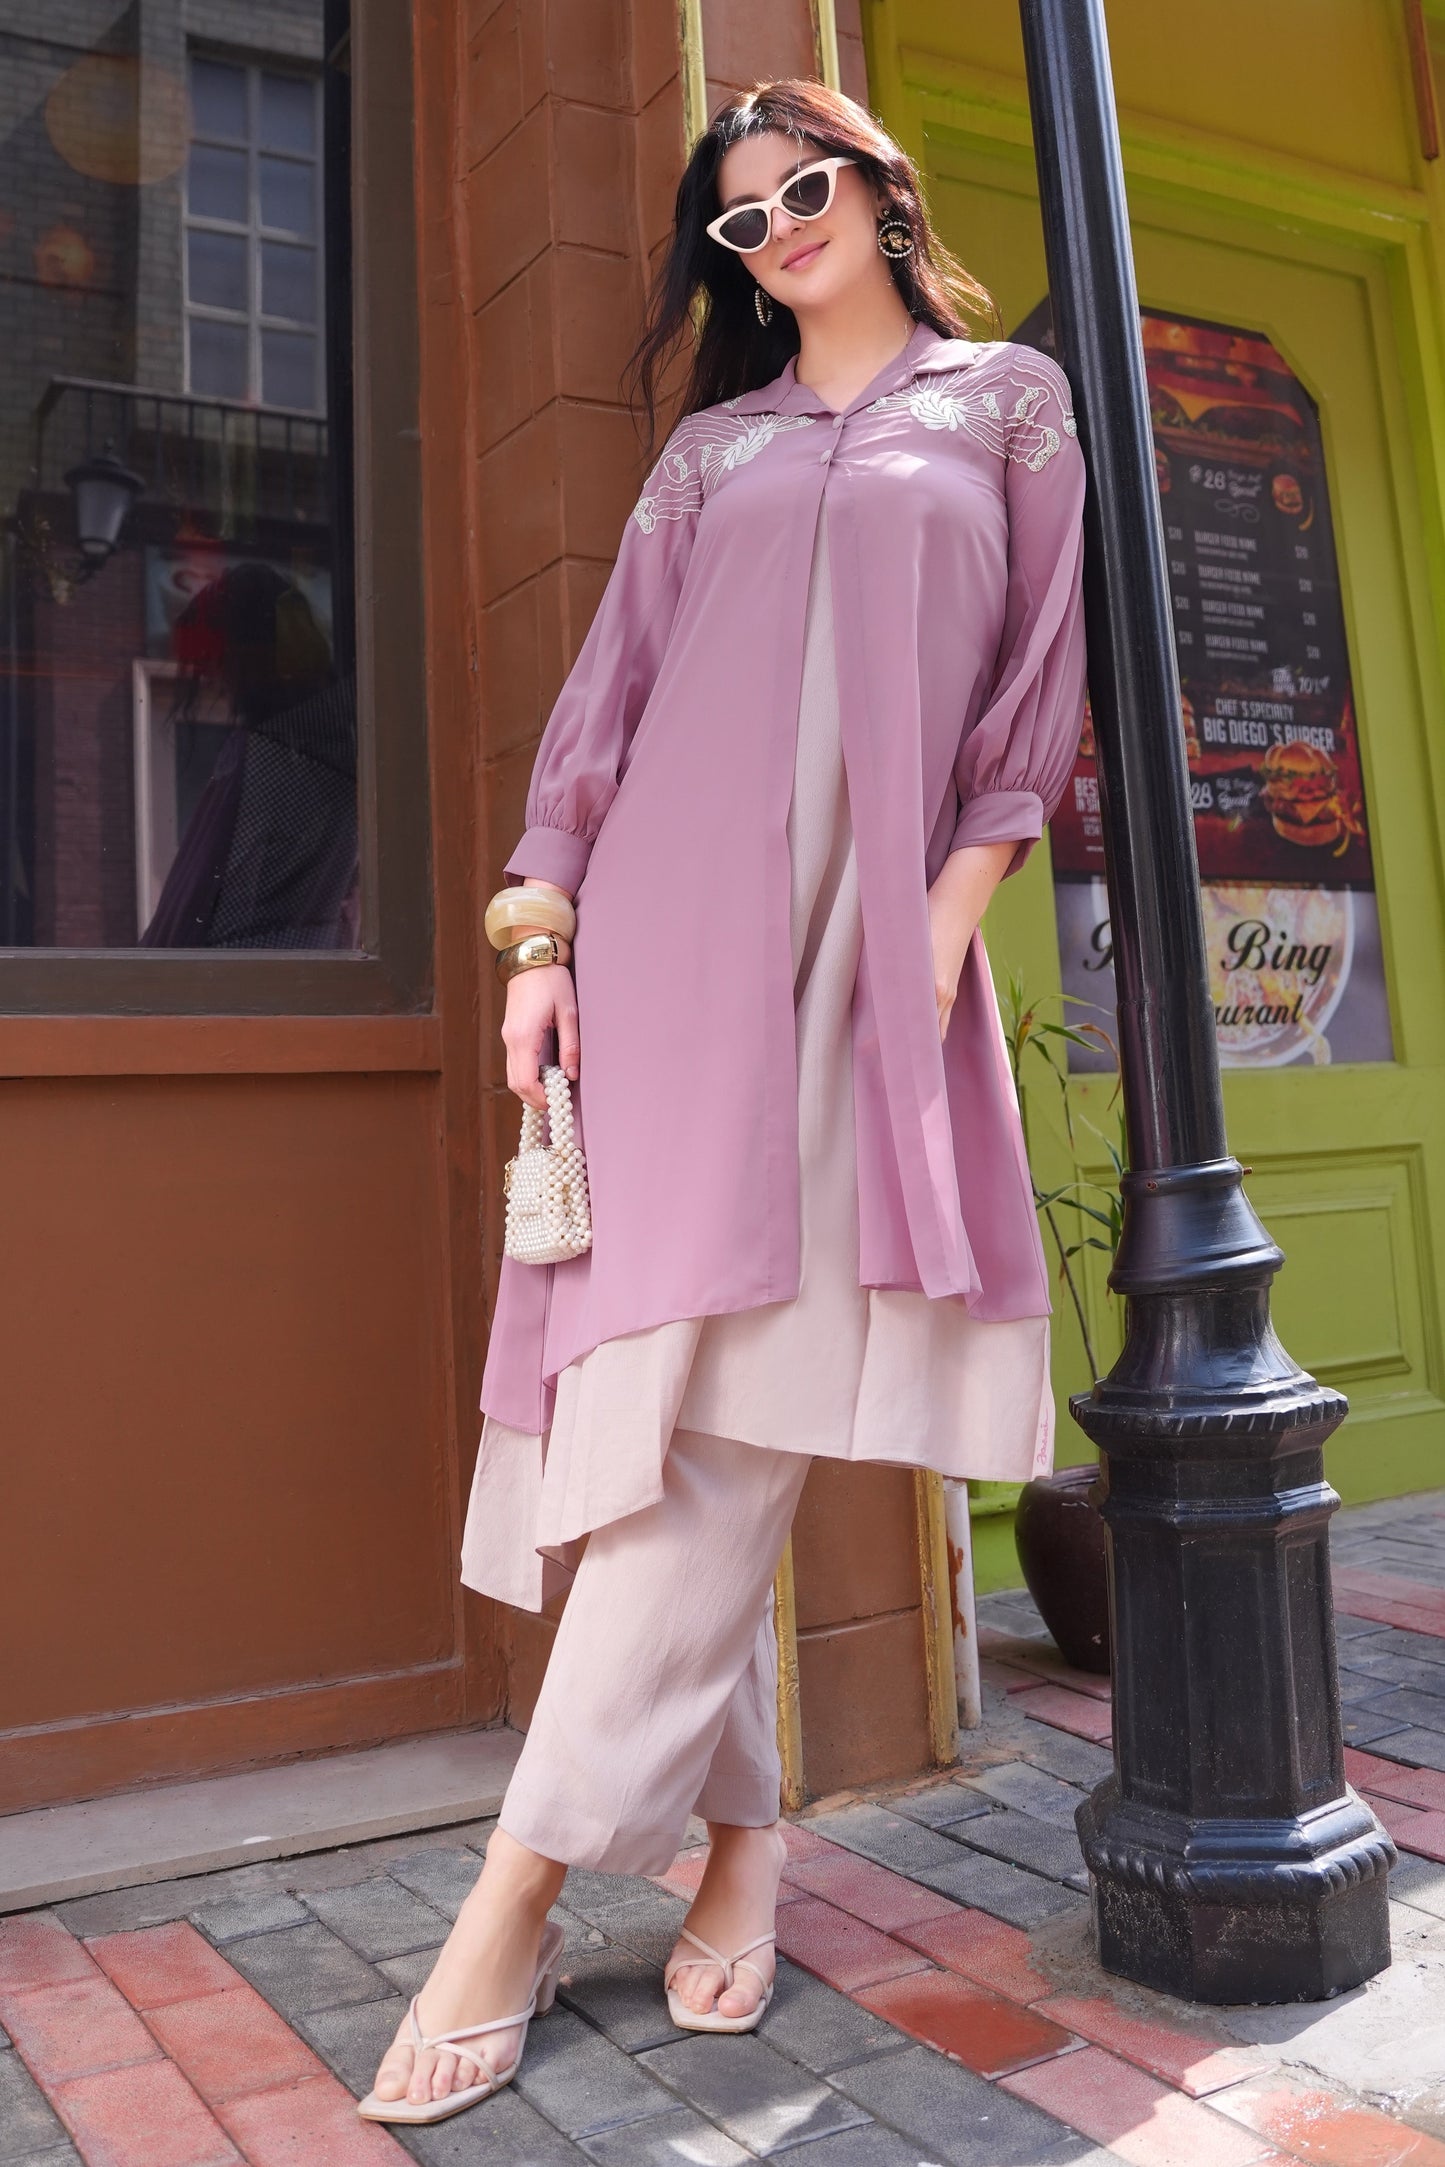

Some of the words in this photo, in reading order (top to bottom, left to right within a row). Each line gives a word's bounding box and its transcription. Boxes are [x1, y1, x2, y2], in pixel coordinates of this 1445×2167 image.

[1250, 701, 1294, 722] SPECIALTY
[1203, 717, 1227, 744] BIG
[1228, 719, 1268, 746] DIEGO
[1284, 725, 1335, 752] BURGER
[1220, 920, 1332, 985] Bing
